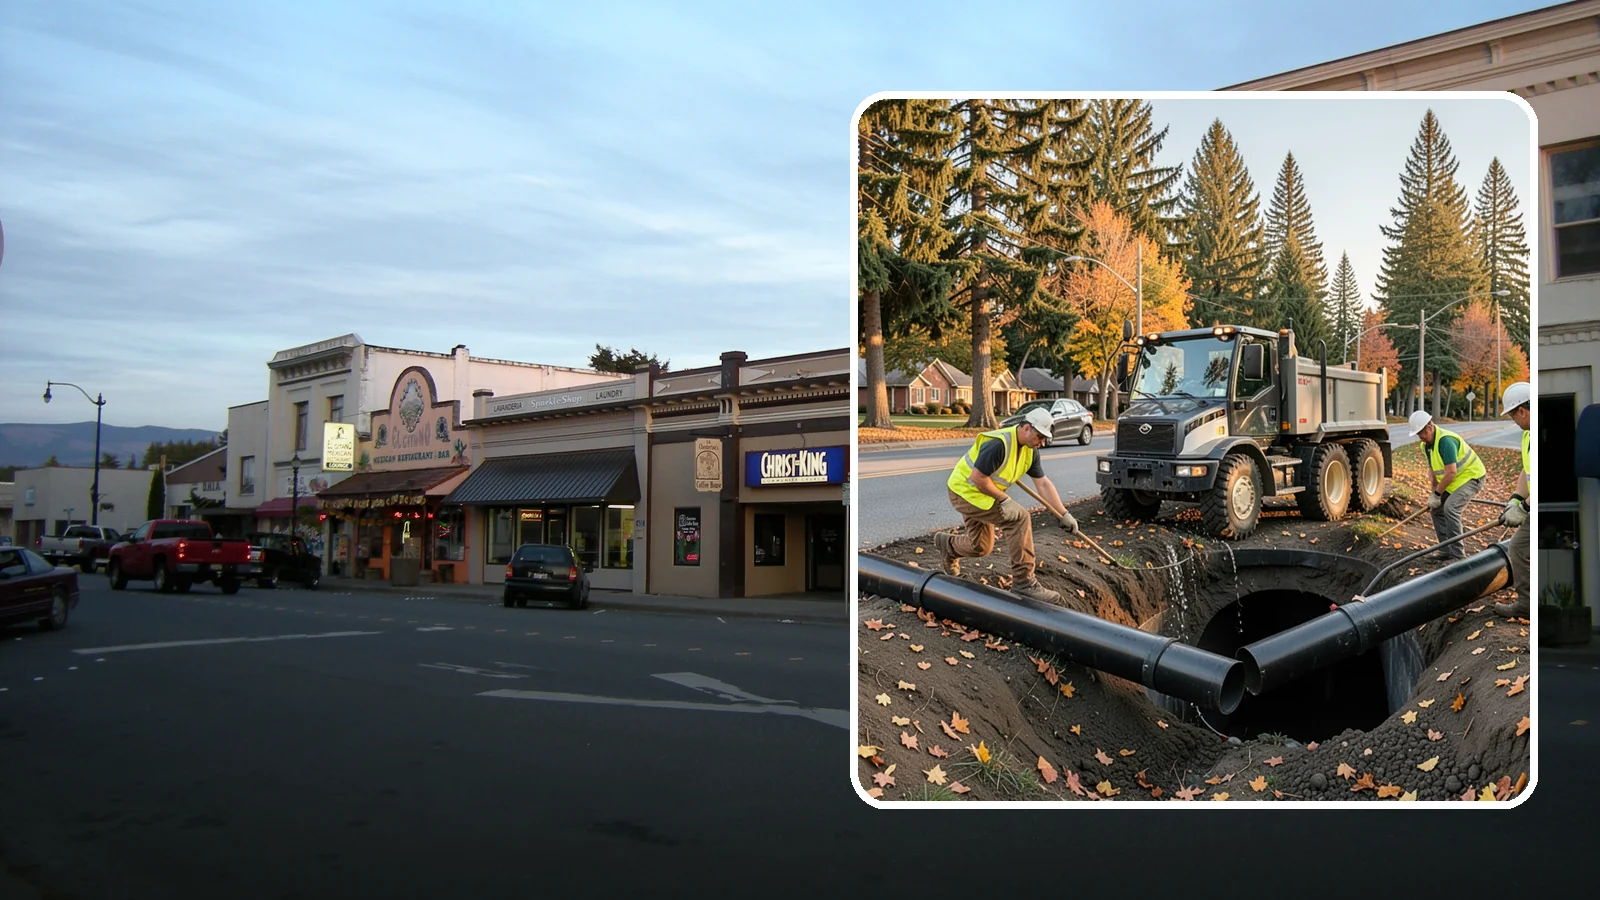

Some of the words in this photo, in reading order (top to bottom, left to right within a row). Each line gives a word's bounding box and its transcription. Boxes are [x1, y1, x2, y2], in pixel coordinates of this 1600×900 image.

[531, 396, 562, 409] Sparkle
[562, 394, 582, 405] Shop
[595, 389, 623, 400] LAUNDRY
[494, 402, 523, 413] LAVANDERIA
[392, 426, 401, 449] EL
[403, 421, 431, 449] GITANO
[374, 455, 396, 464] MEXICAN
[398, 452, 433, 462] RESTAURANT
[438, 450, 450, 459] BAR
[761, 452, 797, 478] CHRIST
[799, 450, 827, 476] KING
